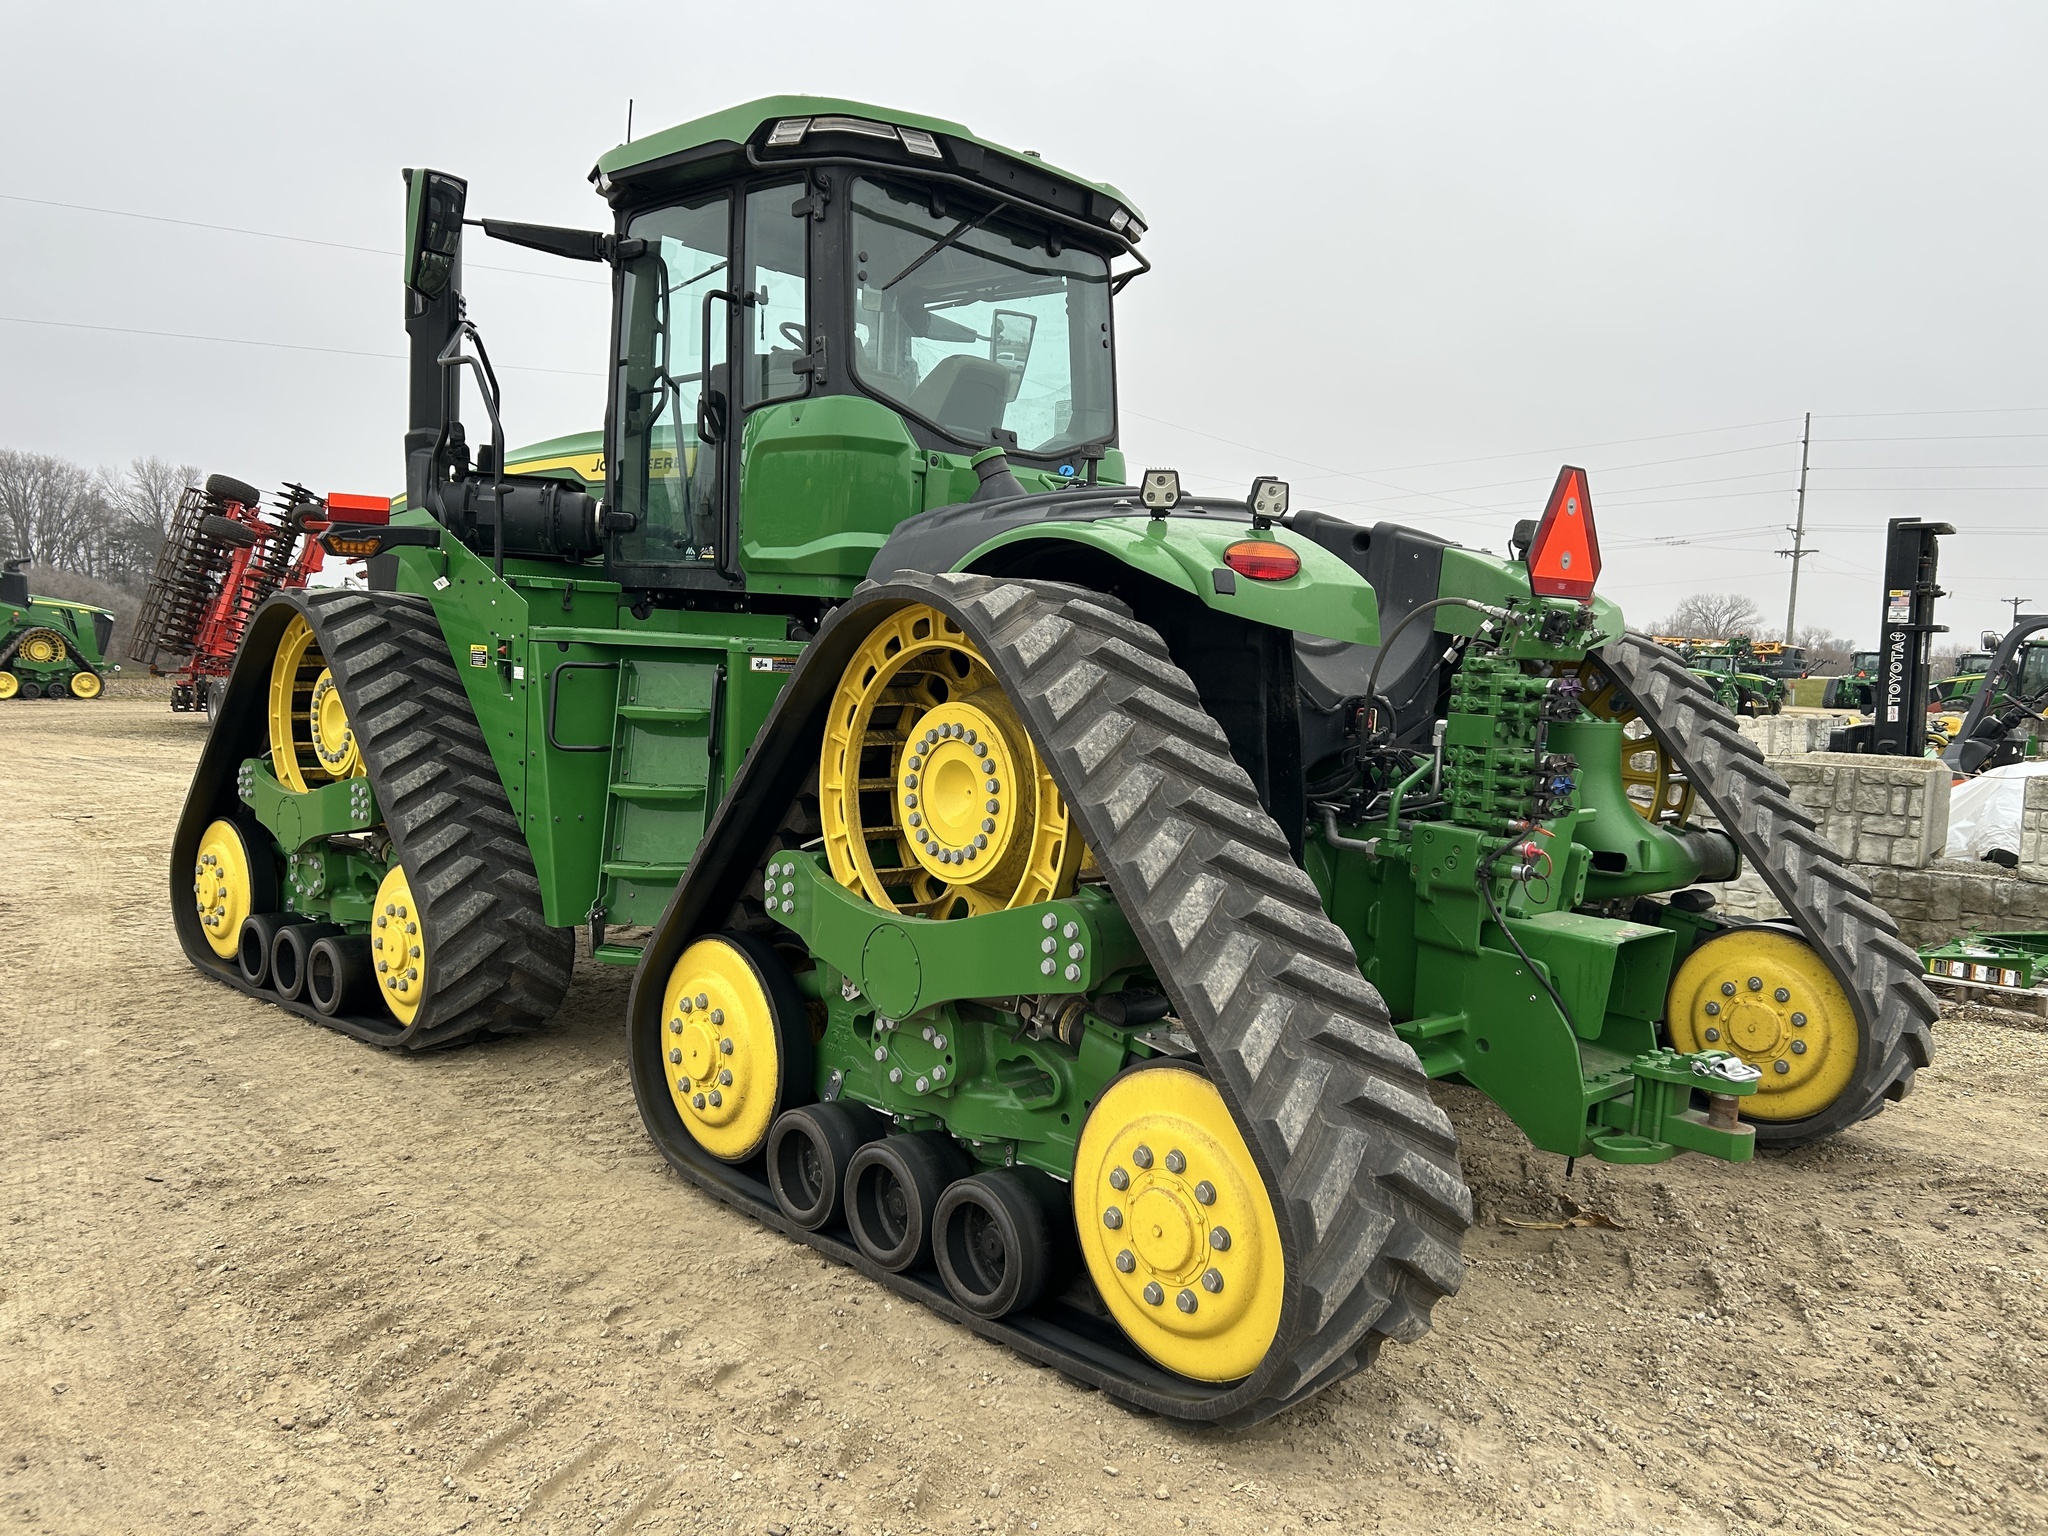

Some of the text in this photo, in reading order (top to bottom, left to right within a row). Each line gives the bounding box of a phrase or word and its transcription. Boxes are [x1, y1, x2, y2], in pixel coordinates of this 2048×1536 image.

[591, 457, 682, 472] JO EERE
[1887, 641, 1904, 705] TOYOTA
